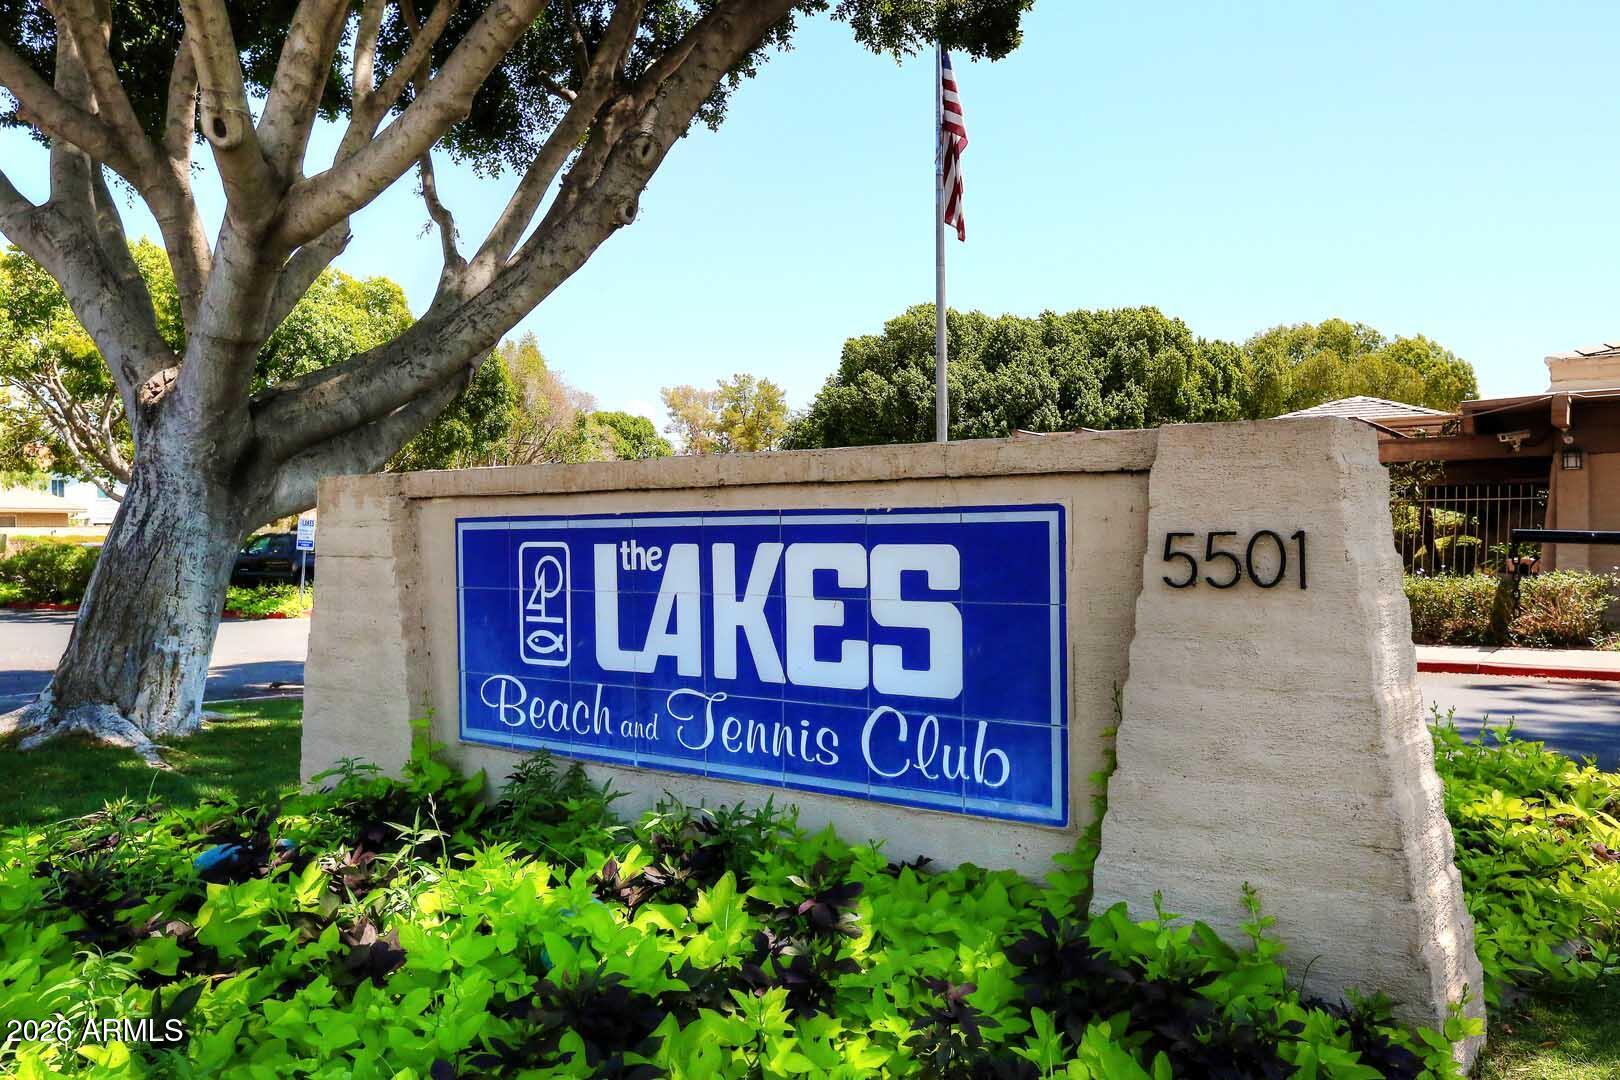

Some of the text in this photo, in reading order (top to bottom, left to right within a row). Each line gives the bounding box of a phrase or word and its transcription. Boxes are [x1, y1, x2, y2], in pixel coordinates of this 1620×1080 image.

[620, 539, 663, 572] the
[1162, 529, 1308, 590] 5501
[594, 542, 963, 699] LAKES
[480, 674, 1011, 787] Beach and Tennis Club
